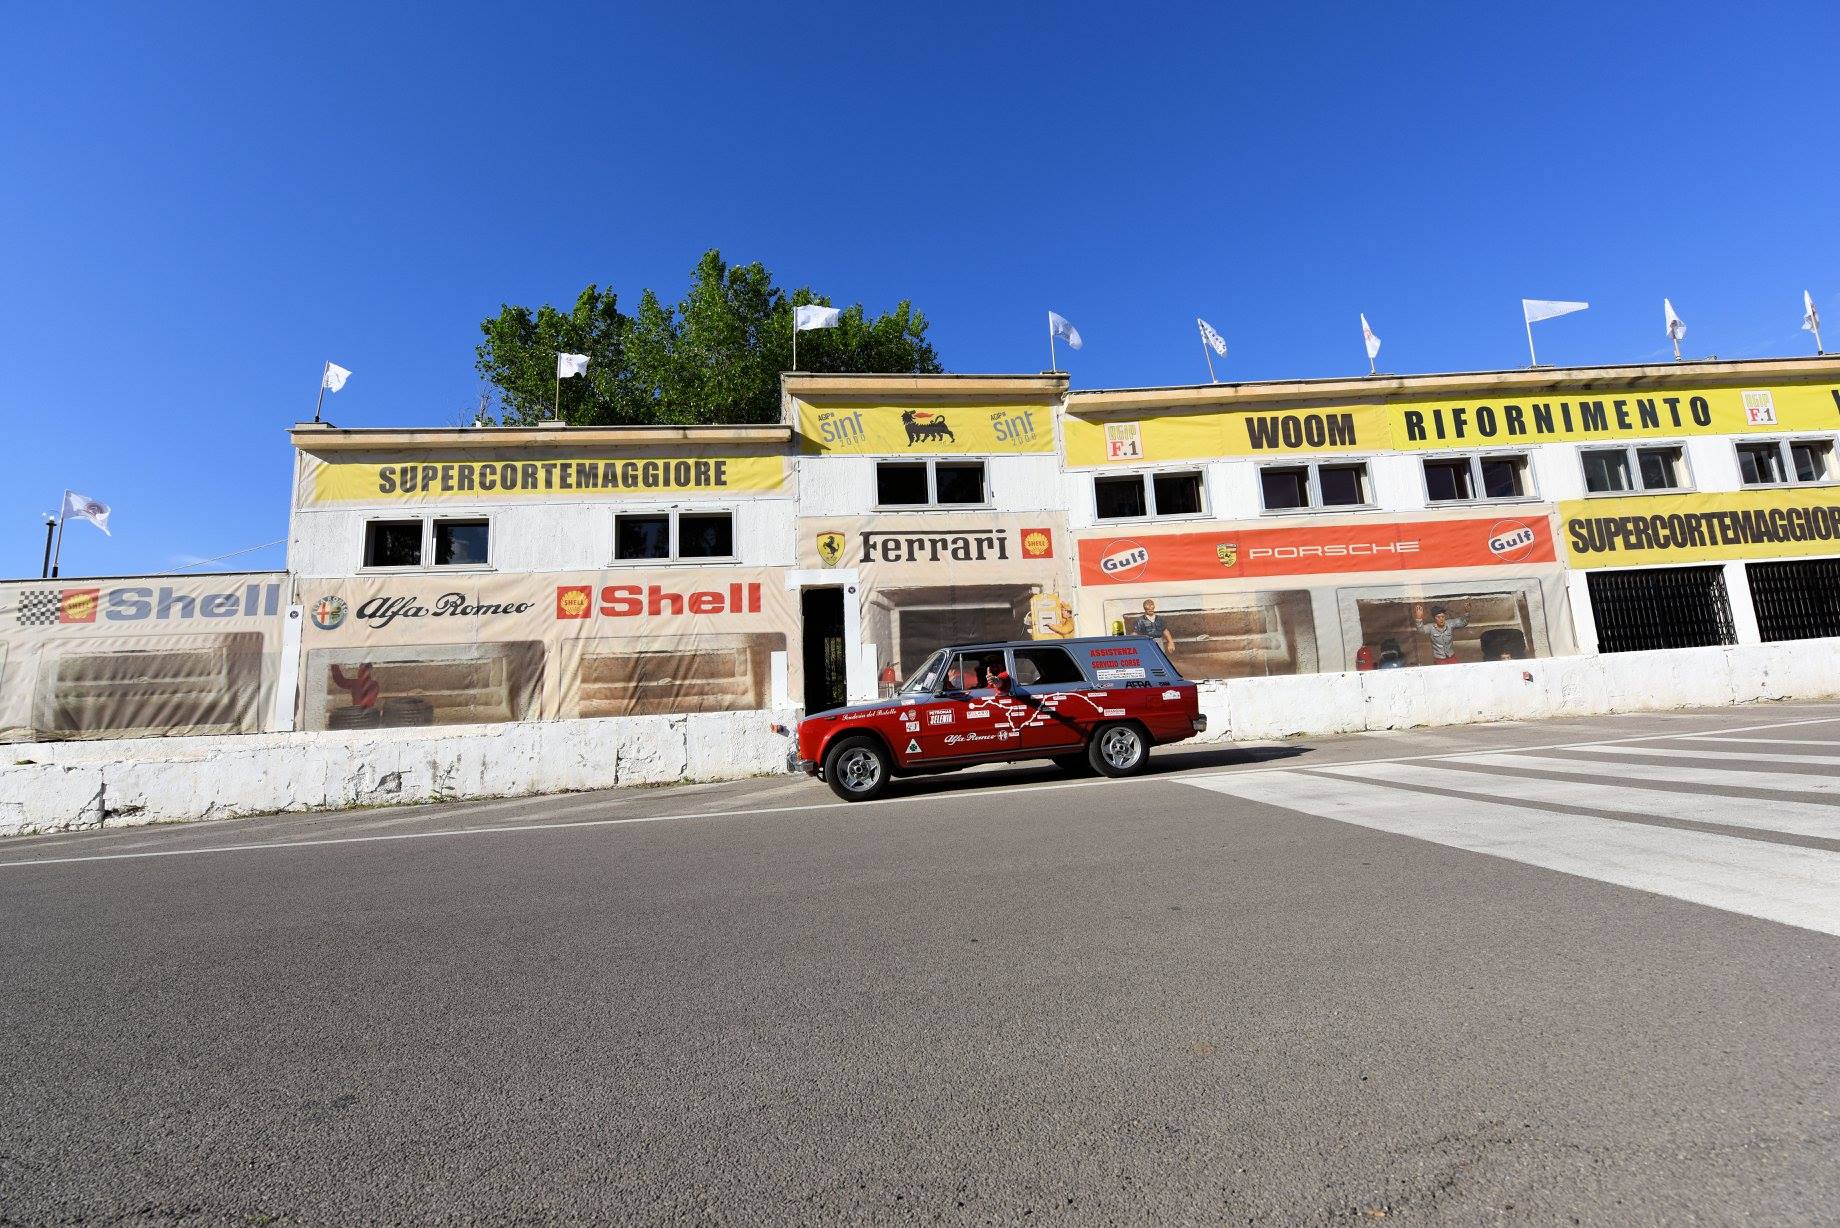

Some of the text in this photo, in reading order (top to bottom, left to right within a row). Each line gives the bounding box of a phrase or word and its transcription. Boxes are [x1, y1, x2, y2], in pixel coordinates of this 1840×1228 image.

[1245, 413, 1357, 449] WOOM
[1404, 396, 1712, 441] RIFORNIMENTO
[1749, 408, 1773, 421] F.1
[1110, 440, 1139, 456] F.1
[379, 460, 728, 493] SUPERCORTEMAGGIORE
[859, 528, 1009, 563] Ferrari
[1249, 541, 1420, 560] PORSCHE
[1490, 530, 1531, 551] Gulf
[1103, 550, 1145, 571] Gulf
[105, 584, 281, 621] Shell
[356, 592, 535, 629] Alfa Romeo
[600, 583, 762, 616] Shell
